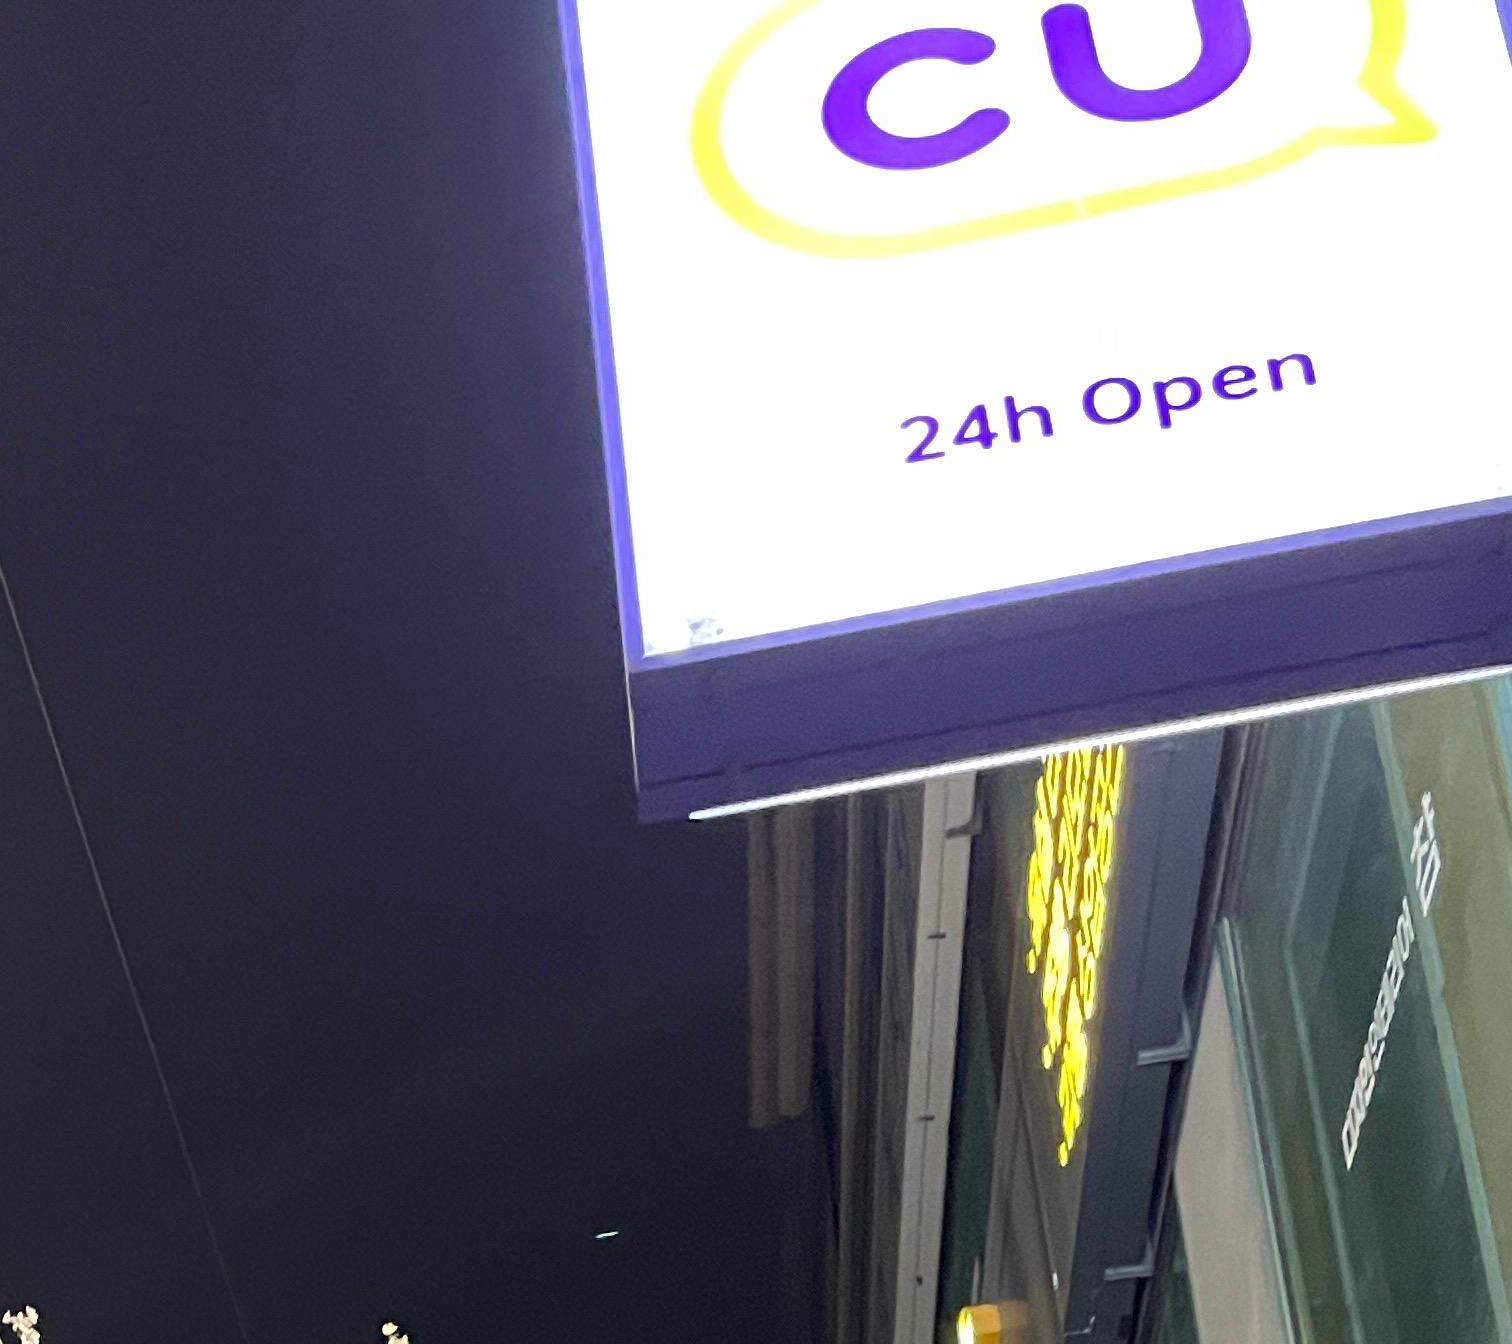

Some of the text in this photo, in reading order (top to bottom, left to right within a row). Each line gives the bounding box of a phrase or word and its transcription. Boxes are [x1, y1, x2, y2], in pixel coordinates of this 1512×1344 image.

[821, 0, 1253, 169] CU
[900, 352, 1317, 463] 24h Open
